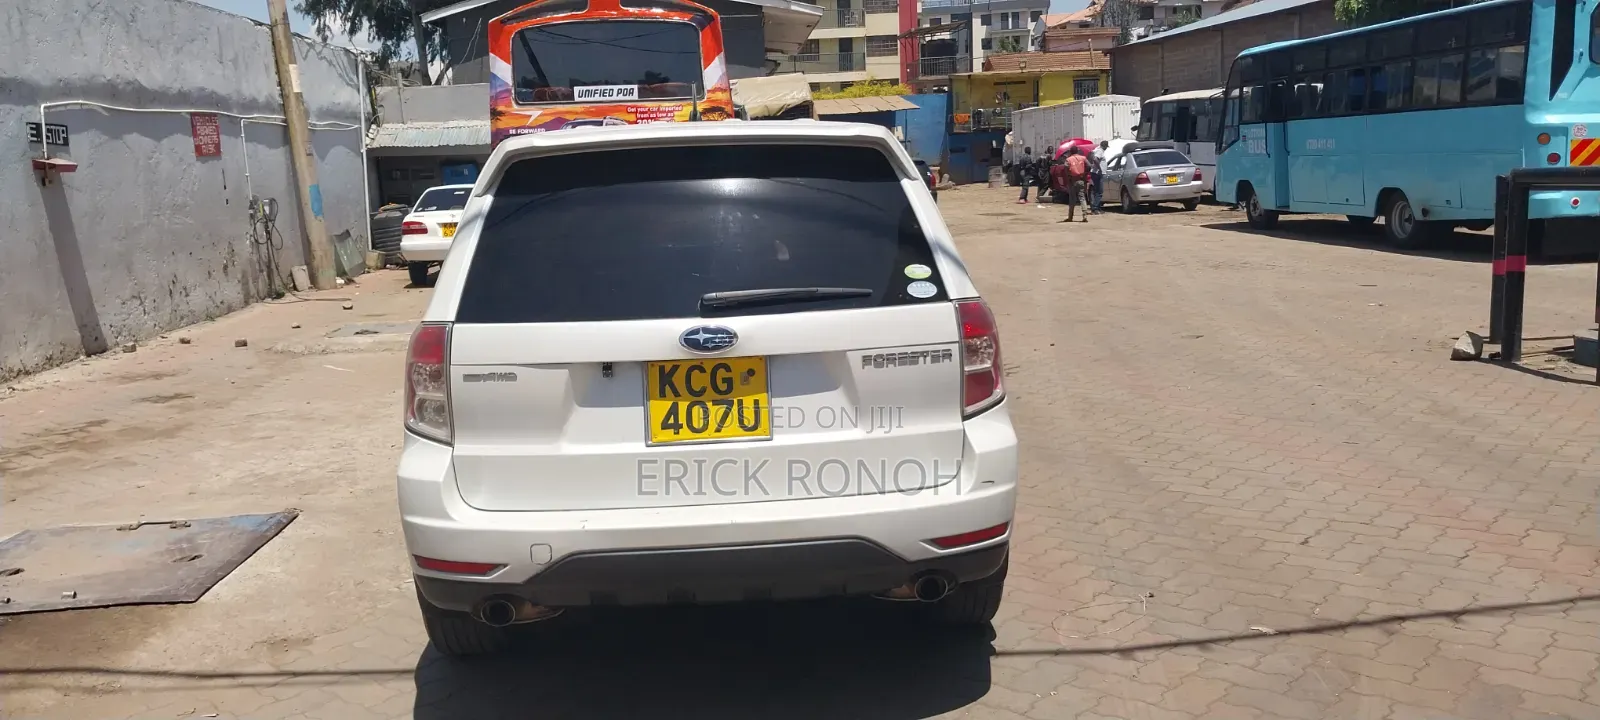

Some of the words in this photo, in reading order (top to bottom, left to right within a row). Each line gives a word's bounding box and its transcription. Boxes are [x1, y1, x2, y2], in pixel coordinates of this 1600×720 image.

[578, 88, 614, 98] UNIFIED
[616, 87, 635, 97] POA
[46, 125, 67, 144] STOP
[1248, 139, 1266, 153] BUS
[861, 348, 953, 370] FORESTER
[658, 362, 734, 398] KCG
[660, 398, 761, 435] 407U
